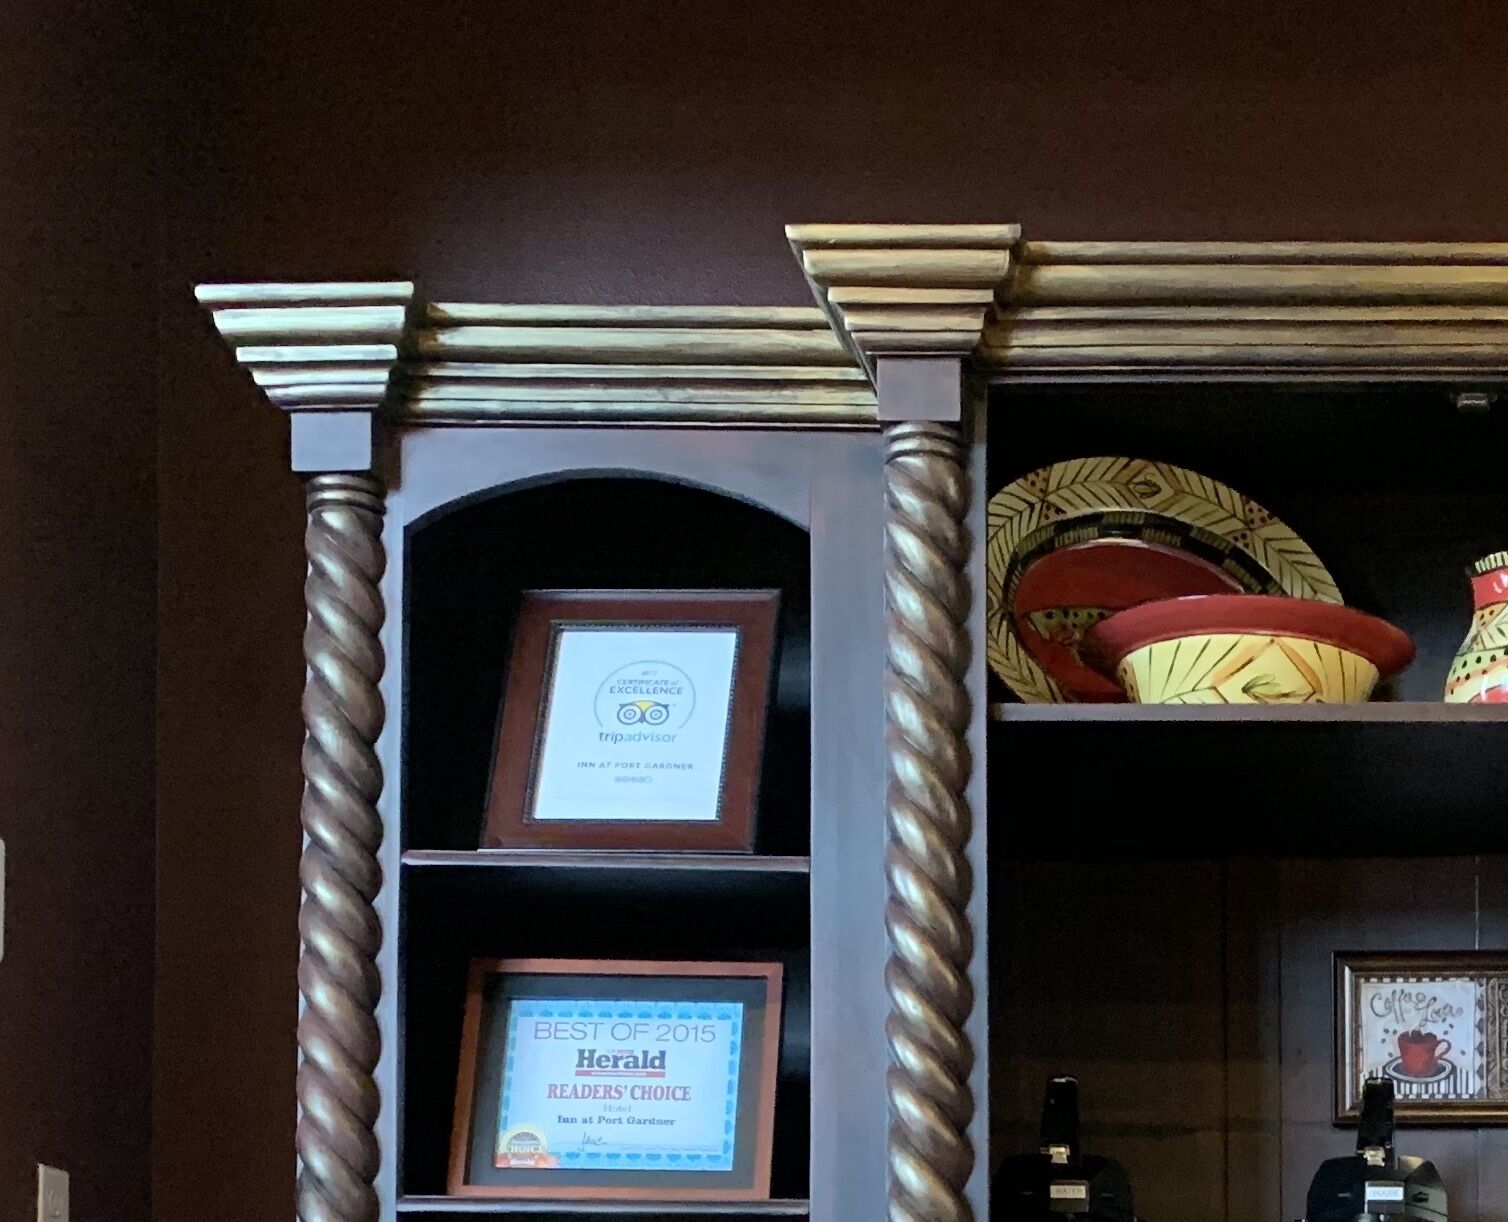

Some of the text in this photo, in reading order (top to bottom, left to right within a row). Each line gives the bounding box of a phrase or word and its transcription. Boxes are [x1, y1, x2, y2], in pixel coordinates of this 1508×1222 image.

[609, 686, 684, 696] EXCELLENCE
[598, 731, 678, 744] tripadvisor
[644, 762, 694, 770] GARDNER
[534, 1022, 716, 1042] BEST OF 2015
[576, 1048, 666, 1070] Herald
[547, 1084, 692, 1100] READERS' CHOICE
[557, 1116, 578, 1124] Inn
[598, 1116, 624, 1125] Port
[627, 1116, 676, 1126] Gardner
